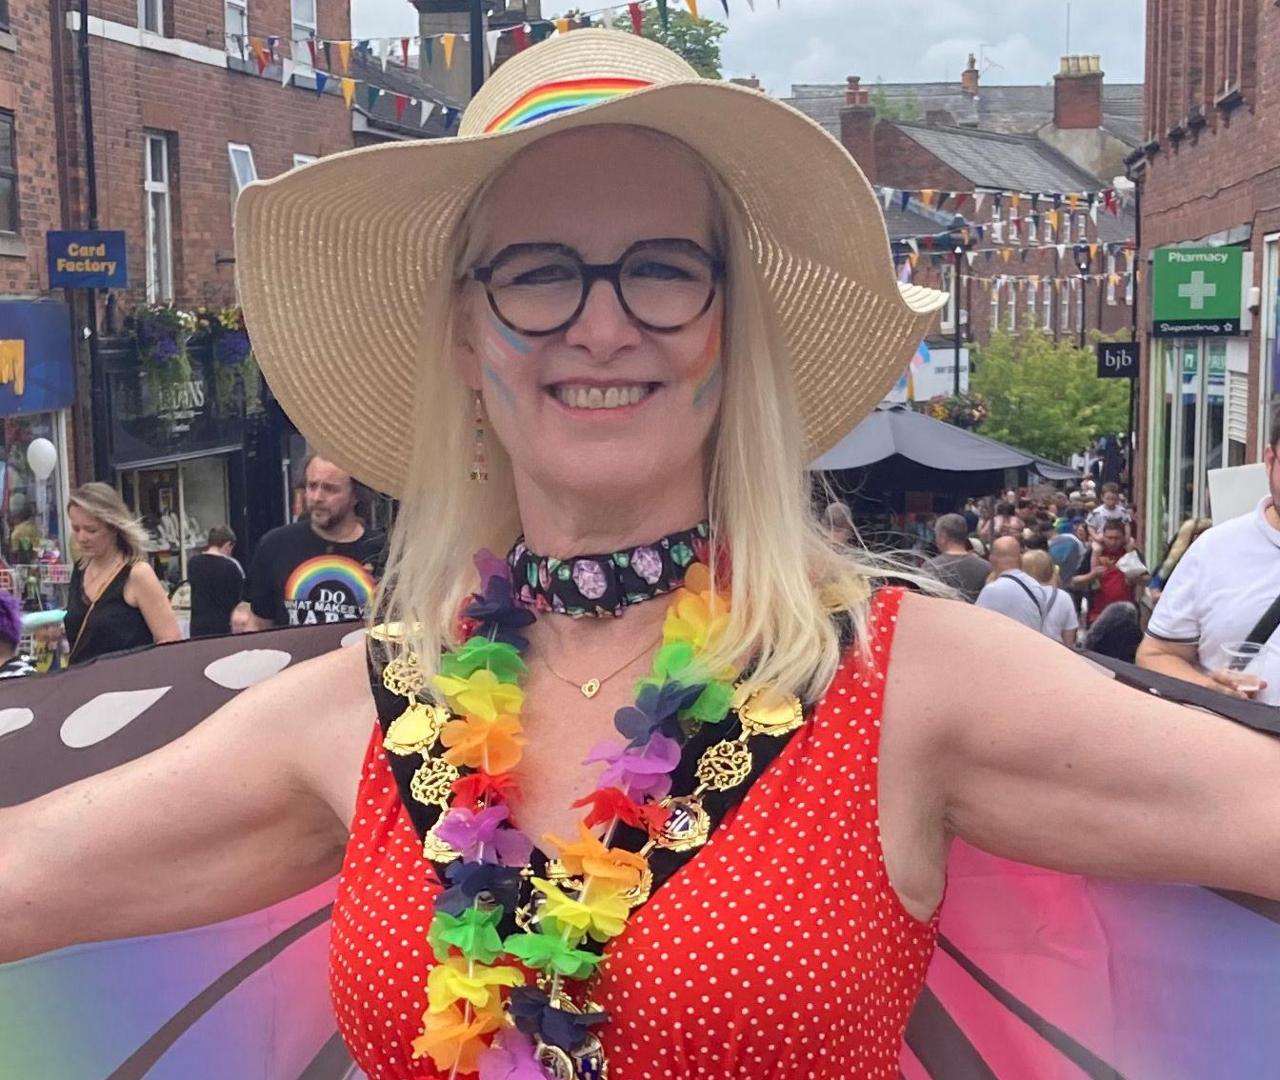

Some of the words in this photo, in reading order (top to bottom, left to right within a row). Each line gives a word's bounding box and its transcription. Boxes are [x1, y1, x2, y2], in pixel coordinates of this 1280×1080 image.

[67, 242, 106, 257] Card
[1168, 252, 1229, 263] Pharmacy
[56, 258, 117, 276] Factory
[1160, 323, 1220, 333] Superdrug
[1105, 350, 1132, 371] bjb
[320, 589, 346, 604] DO
[285, 600, 313, 611] WHAT
[314, 601, 355, 614] MAKES
